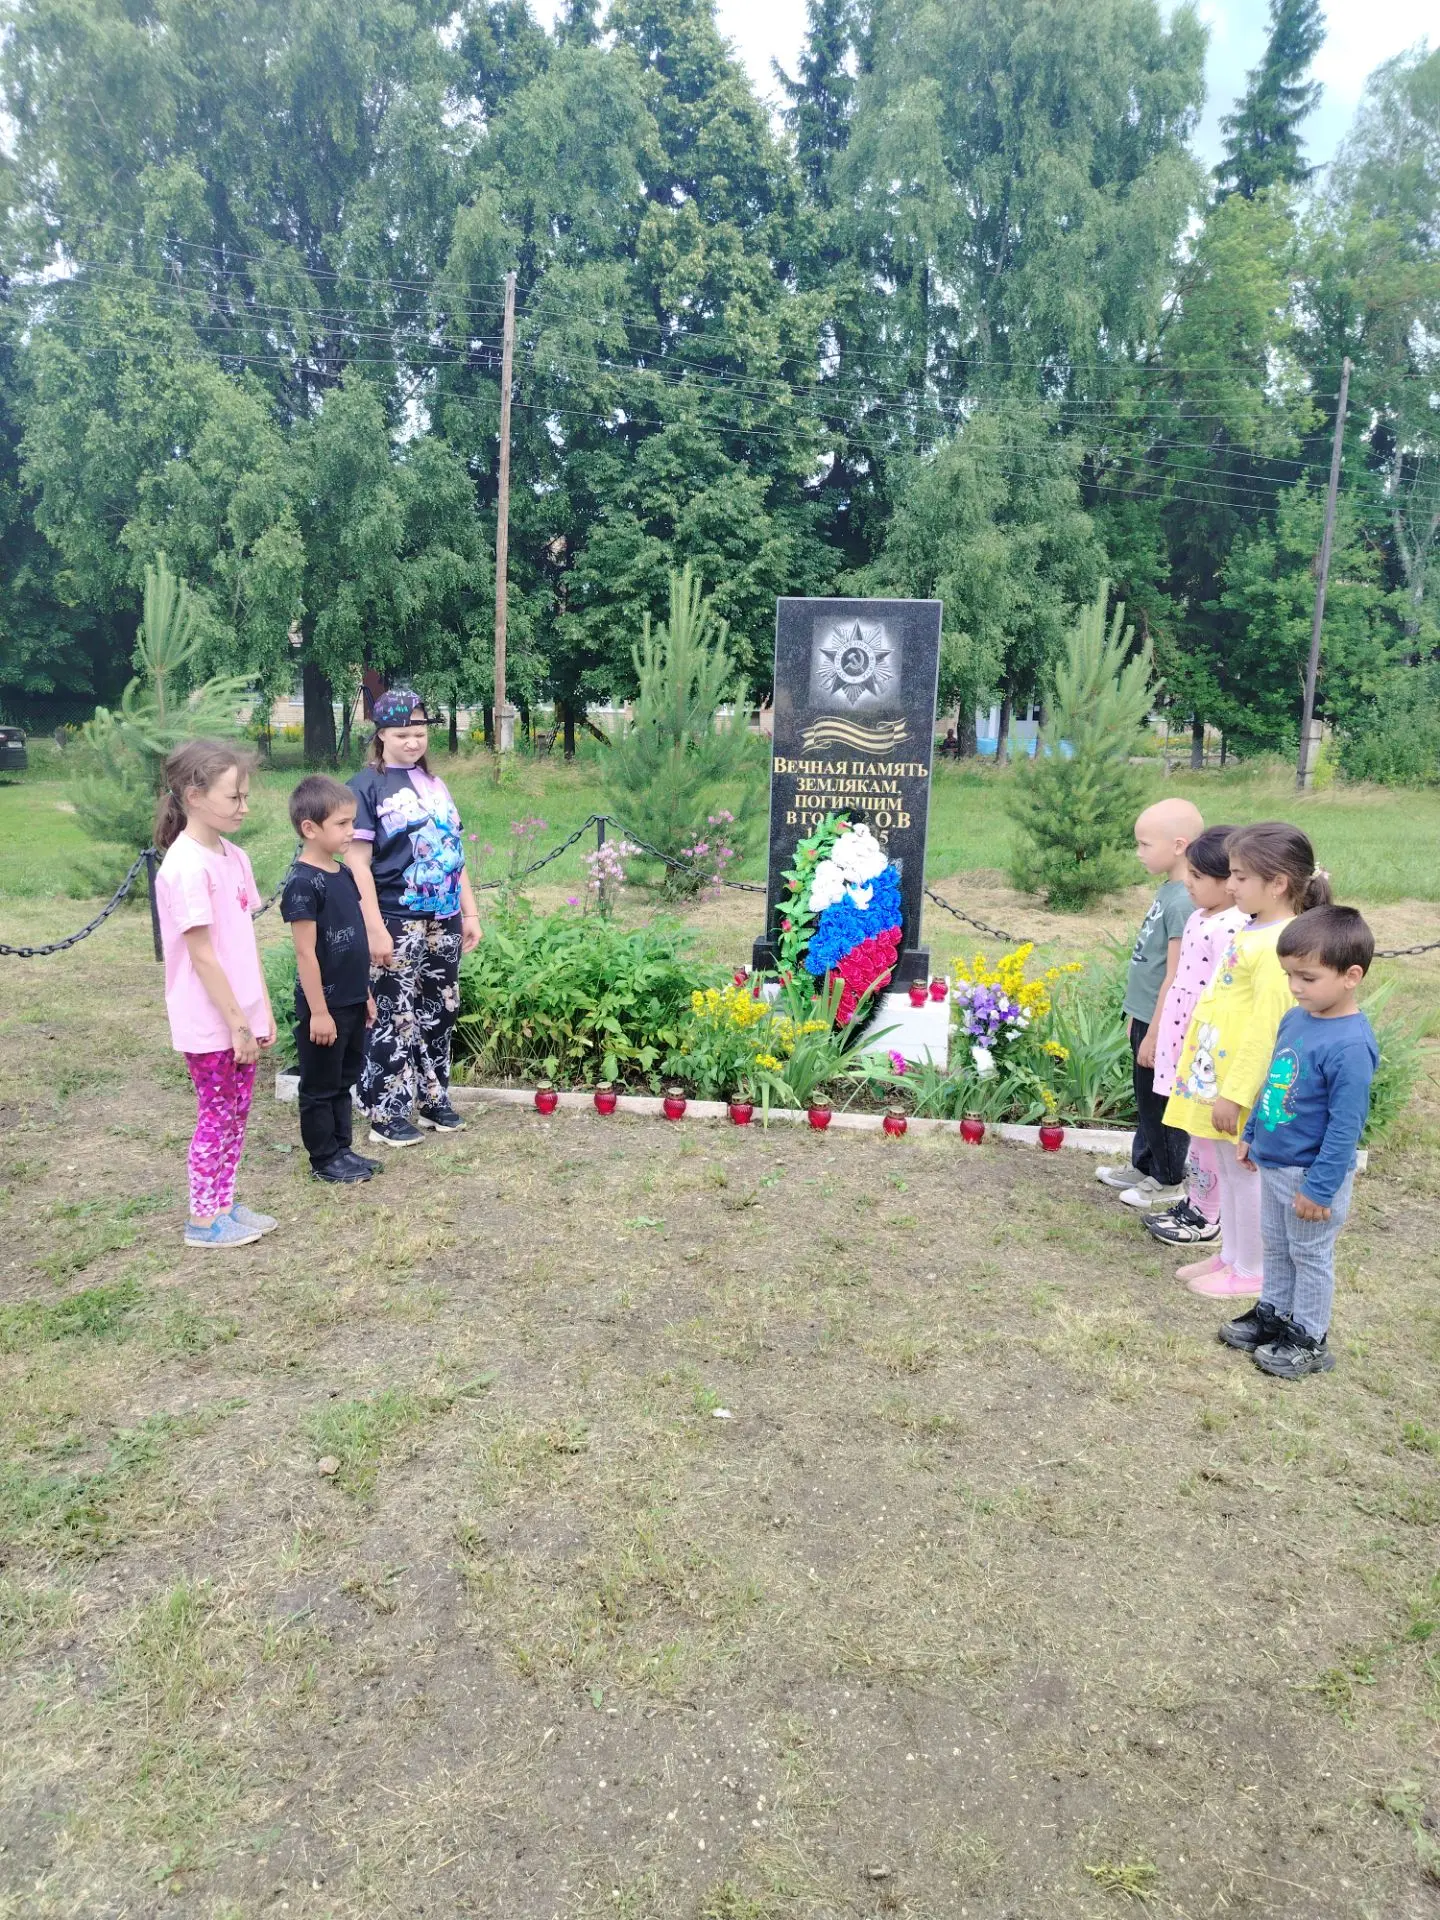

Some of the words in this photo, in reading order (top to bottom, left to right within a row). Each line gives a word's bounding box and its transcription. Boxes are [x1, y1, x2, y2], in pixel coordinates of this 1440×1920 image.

[773, 756, 848, 775] ВЕЧНАЯ
[851, 761, 929, 777] ПАМЯТЬ
[795, 794, 902, 811] ПОГИБШИМ
[786, 811, 797, 825] В
